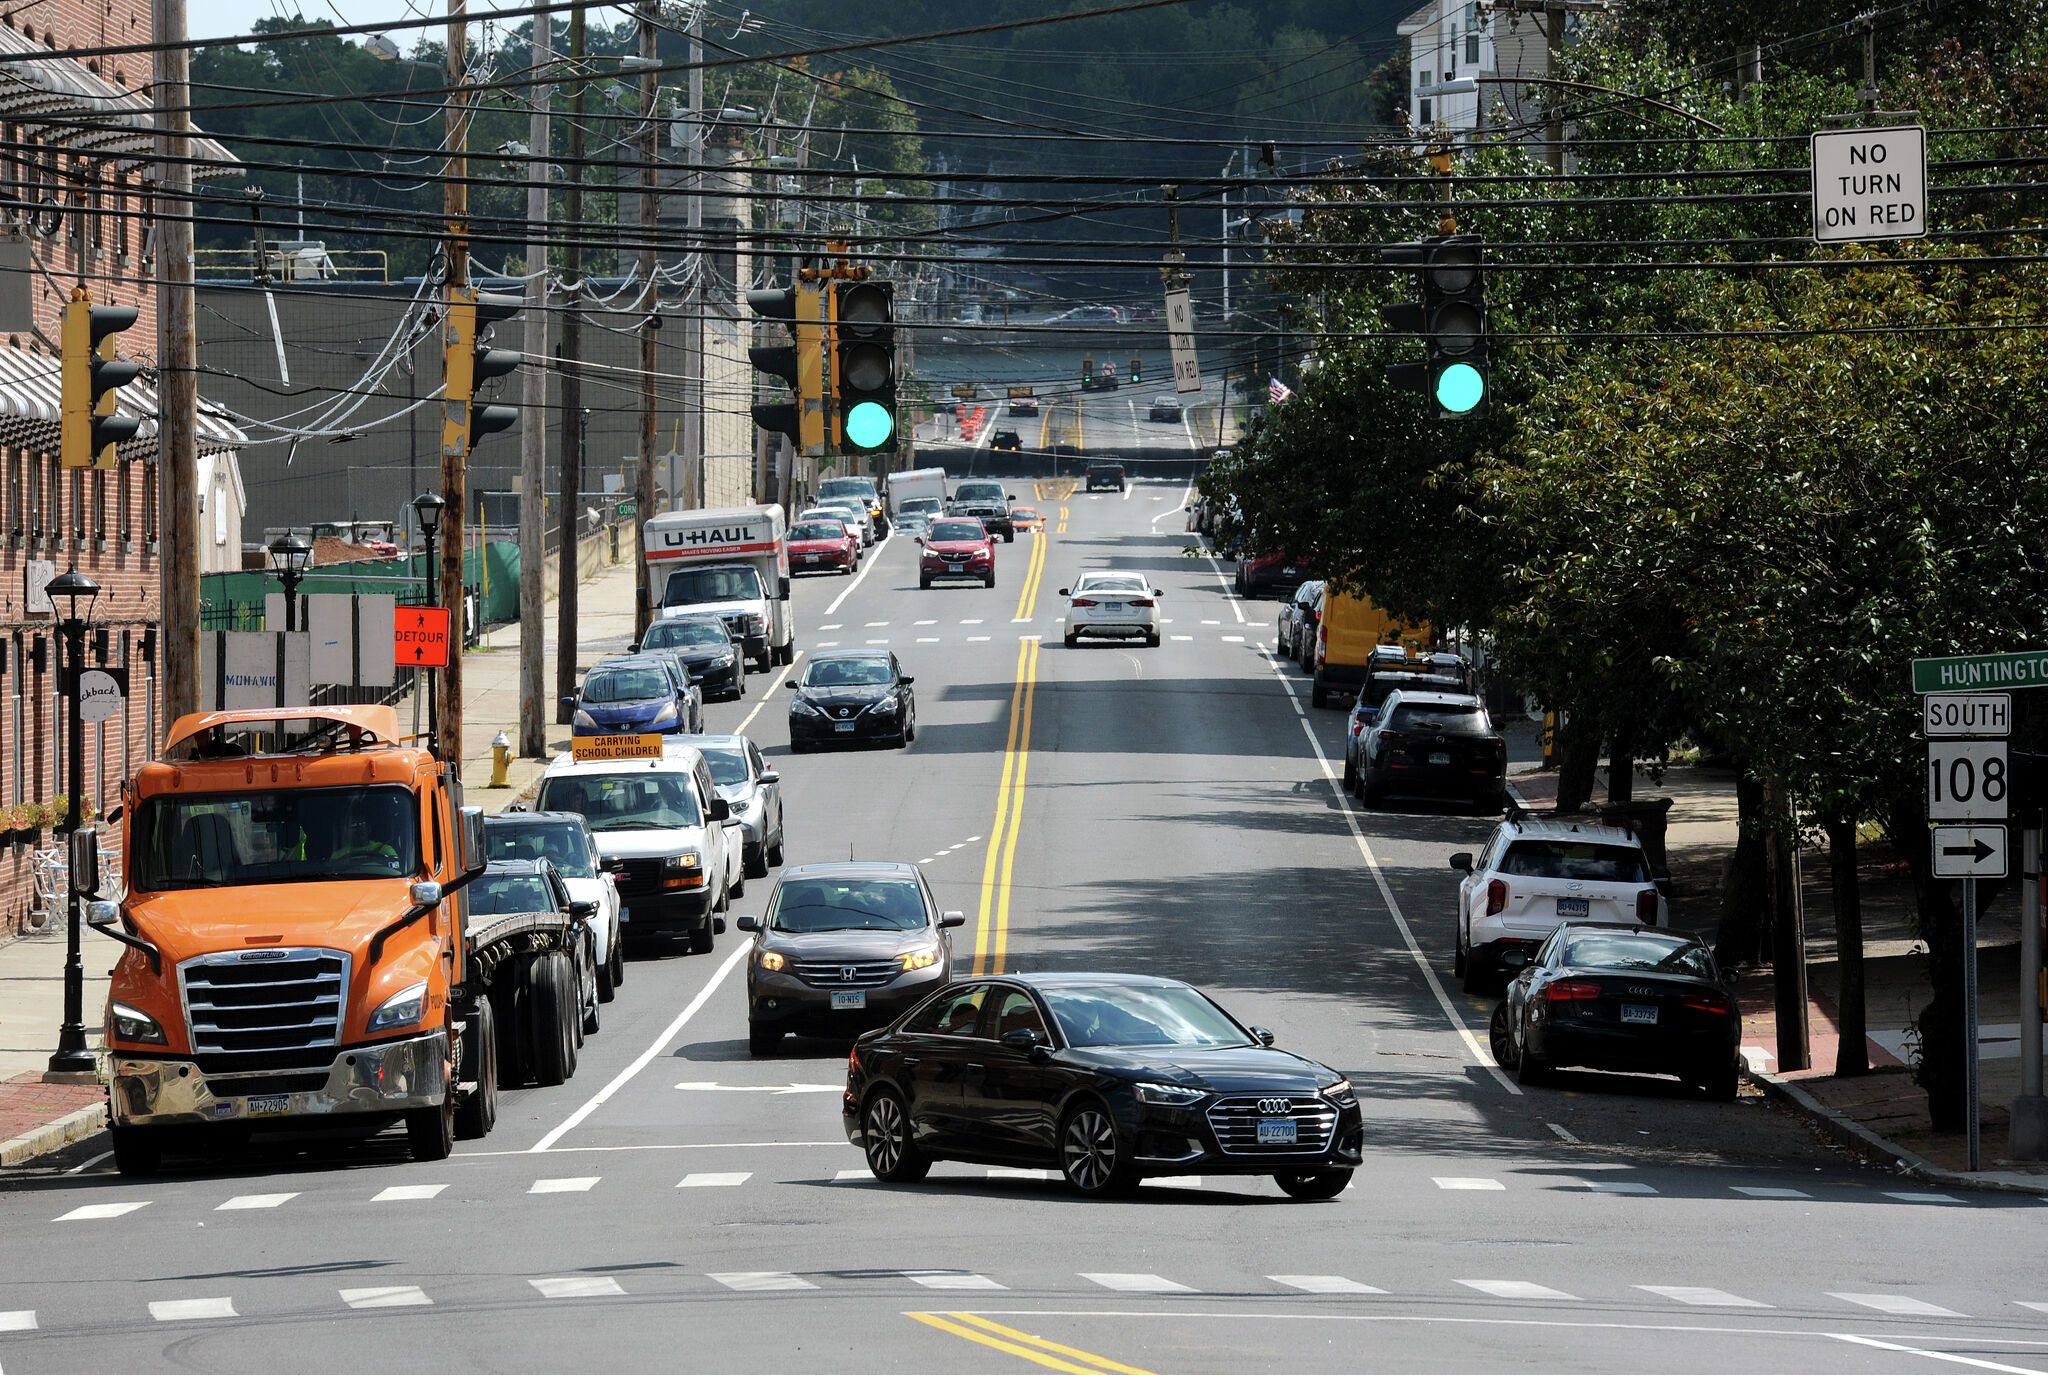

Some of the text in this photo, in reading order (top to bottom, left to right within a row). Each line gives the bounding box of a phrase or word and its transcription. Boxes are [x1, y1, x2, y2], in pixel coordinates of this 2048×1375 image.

[1849, 143, 1887, 165] NO
[1838, 173, 1901, 196] TURN
[1825, 203, 1915, 227] ON RED
[1173, 304, 1184, 324] NO
[1176, 360, 1197, 381] ON RED
[664, 527, 756, 546] U-HAUL
[395, 630, 444, 644] DETOUR
[225, 674, 276, 687] MOHAWK
[80, 685, 115, 702] ckback
[1929, 703, 2006, 726] SOUTH
[594, 735, 641, 747] CARRYING
[575, 745, 660, 758] SCHOOL CHILDREN
[1931, 757, 2006, 802] 108
